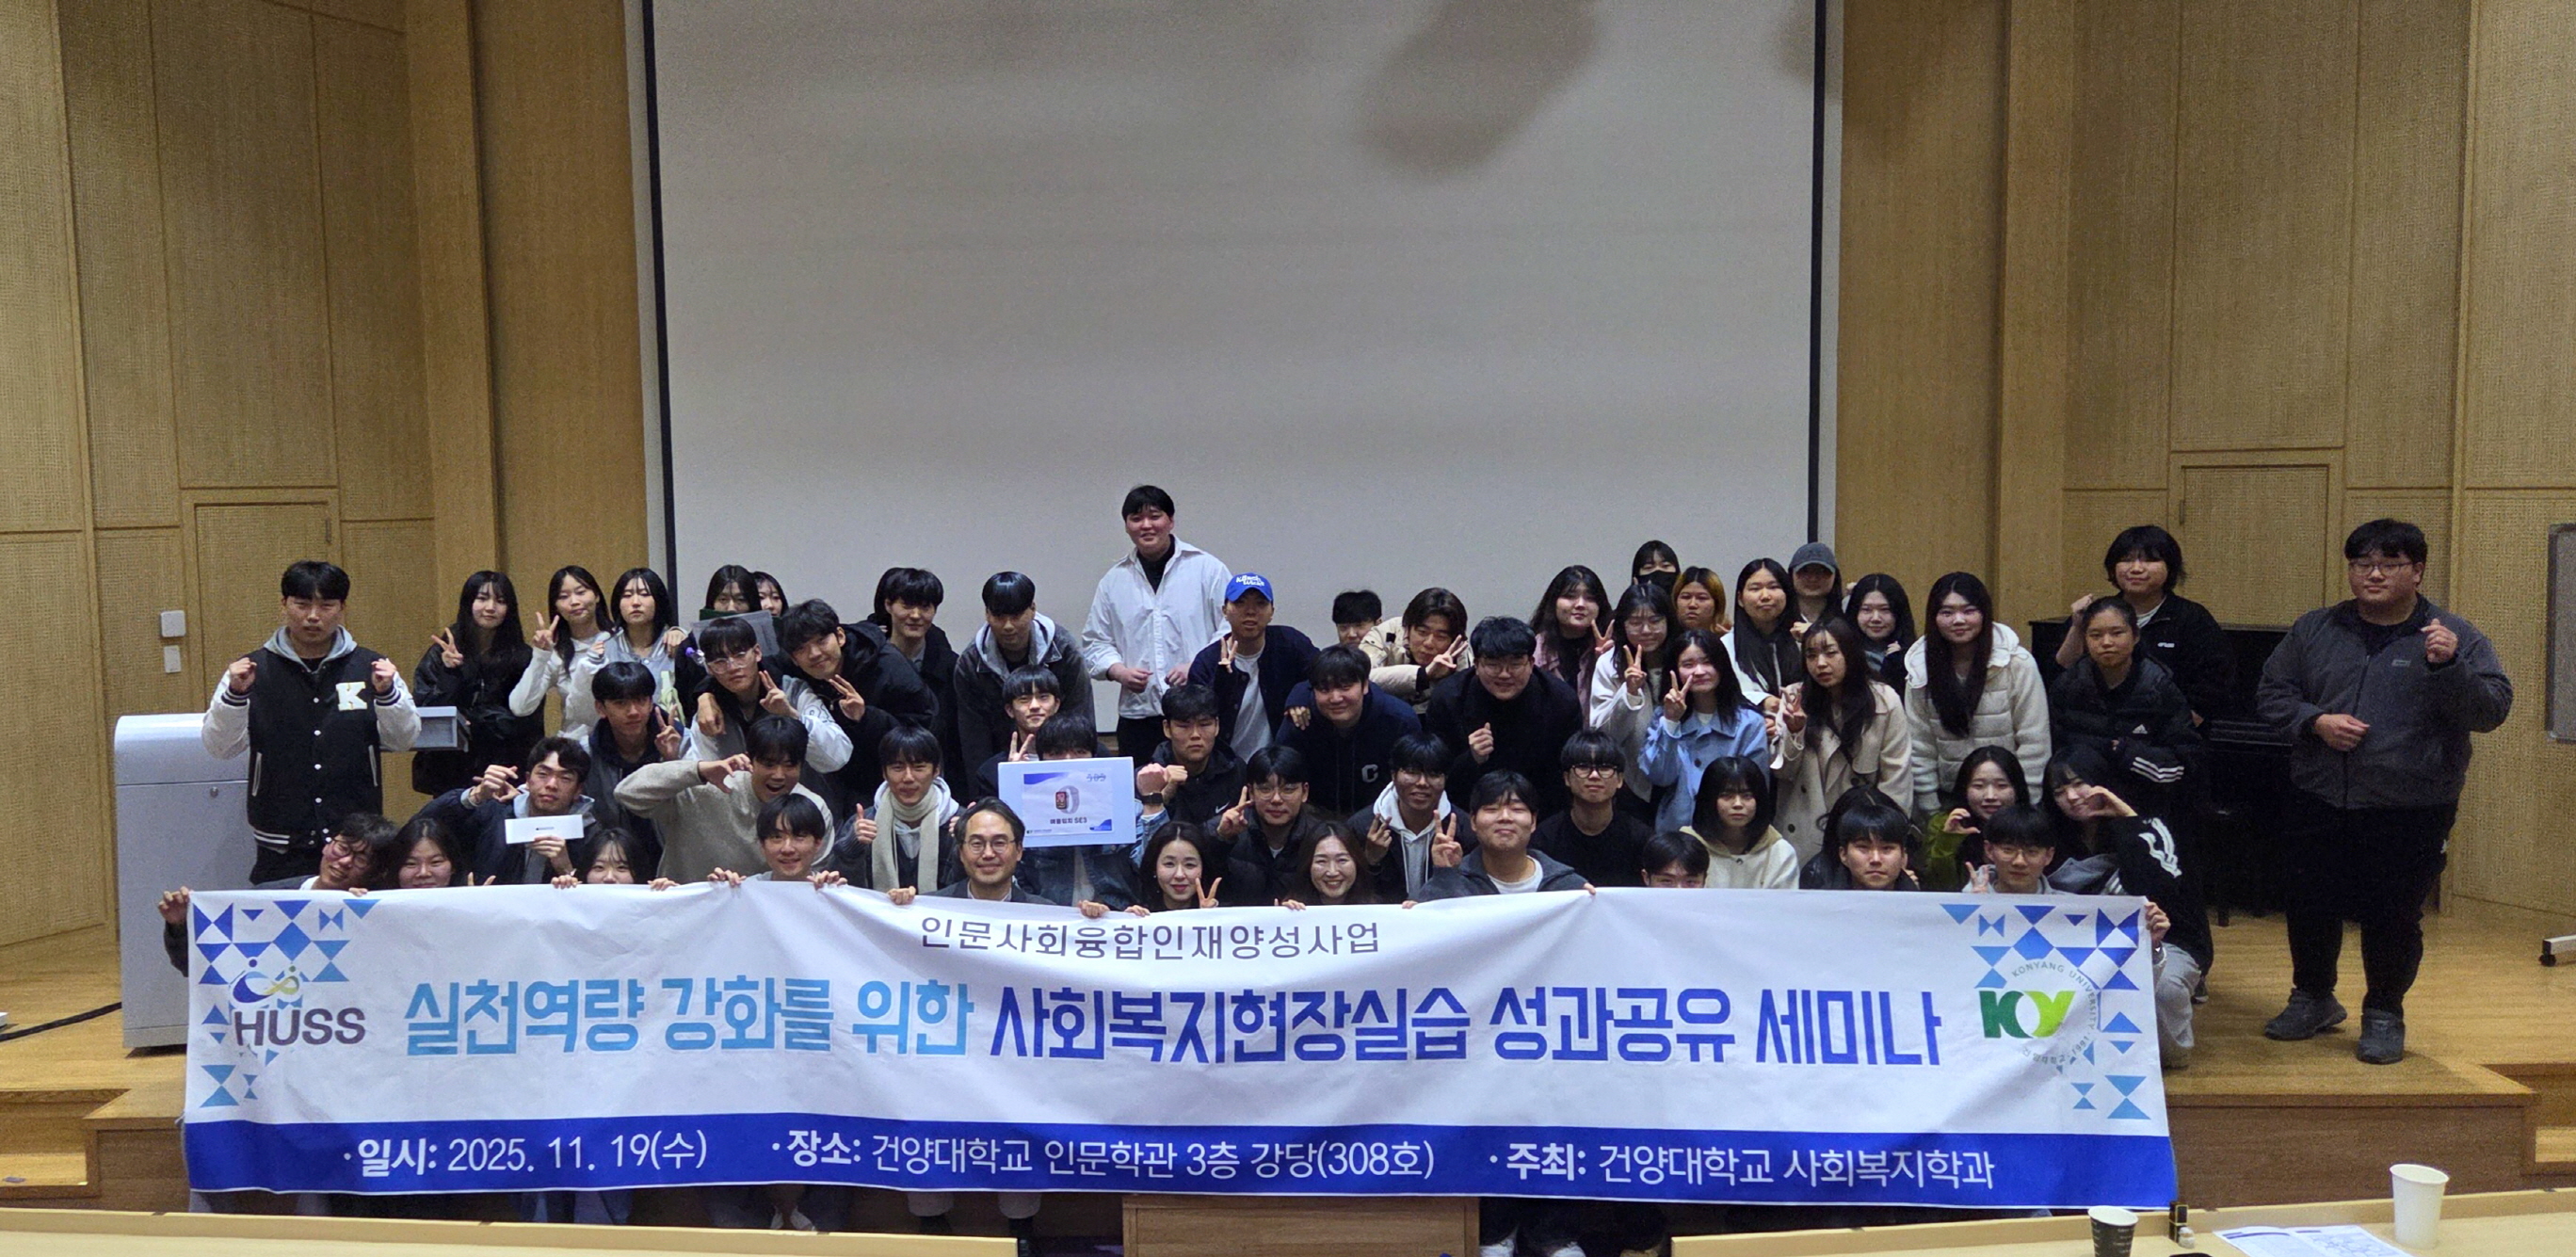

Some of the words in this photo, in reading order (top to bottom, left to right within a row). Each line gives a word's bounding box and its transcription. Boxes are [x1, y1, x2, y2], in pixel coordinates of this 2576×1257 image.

[335, 681, 368, 711] K
[921, 915, 1380, 960] 인문사회융합인재양성사업
[2011, 960, 2066, 978] KONYANG
[2068, 970, 2097, 1030] UNIVERSITY
[233, 1007, 366, 1046] HUSS
[404, 978, 645, 1056] 실천역량
[661, 975, 834, 1052] 강화를
[852, 978, 975, 1056] 위한
[990, 985, 1472, 1065] 사회복지현장실습
[1489, 986, 1736, 1063] 성과공유
[1756, 988, 1942, 1066] 세미나
[2071, 1034, 2091, 1056] 1991
[447, 1137, 534, 1172] 2025.
[548, 1136, 595, 1171] 11.
[611, 1129, 707, 1170] 19(수)
[872, 1135, 1033, 1174] 건양대학교
[1045, 1140, 1178, 1178] 인문학관
[1186, 1141, 1240, 1179] 3층
[1251, 1140, 1434, 1179] 강당(308호)
[1600, 1145, 1774, 1185] 건양대학교
[1783, 1149, 1995, 1189] 사회복지학과
